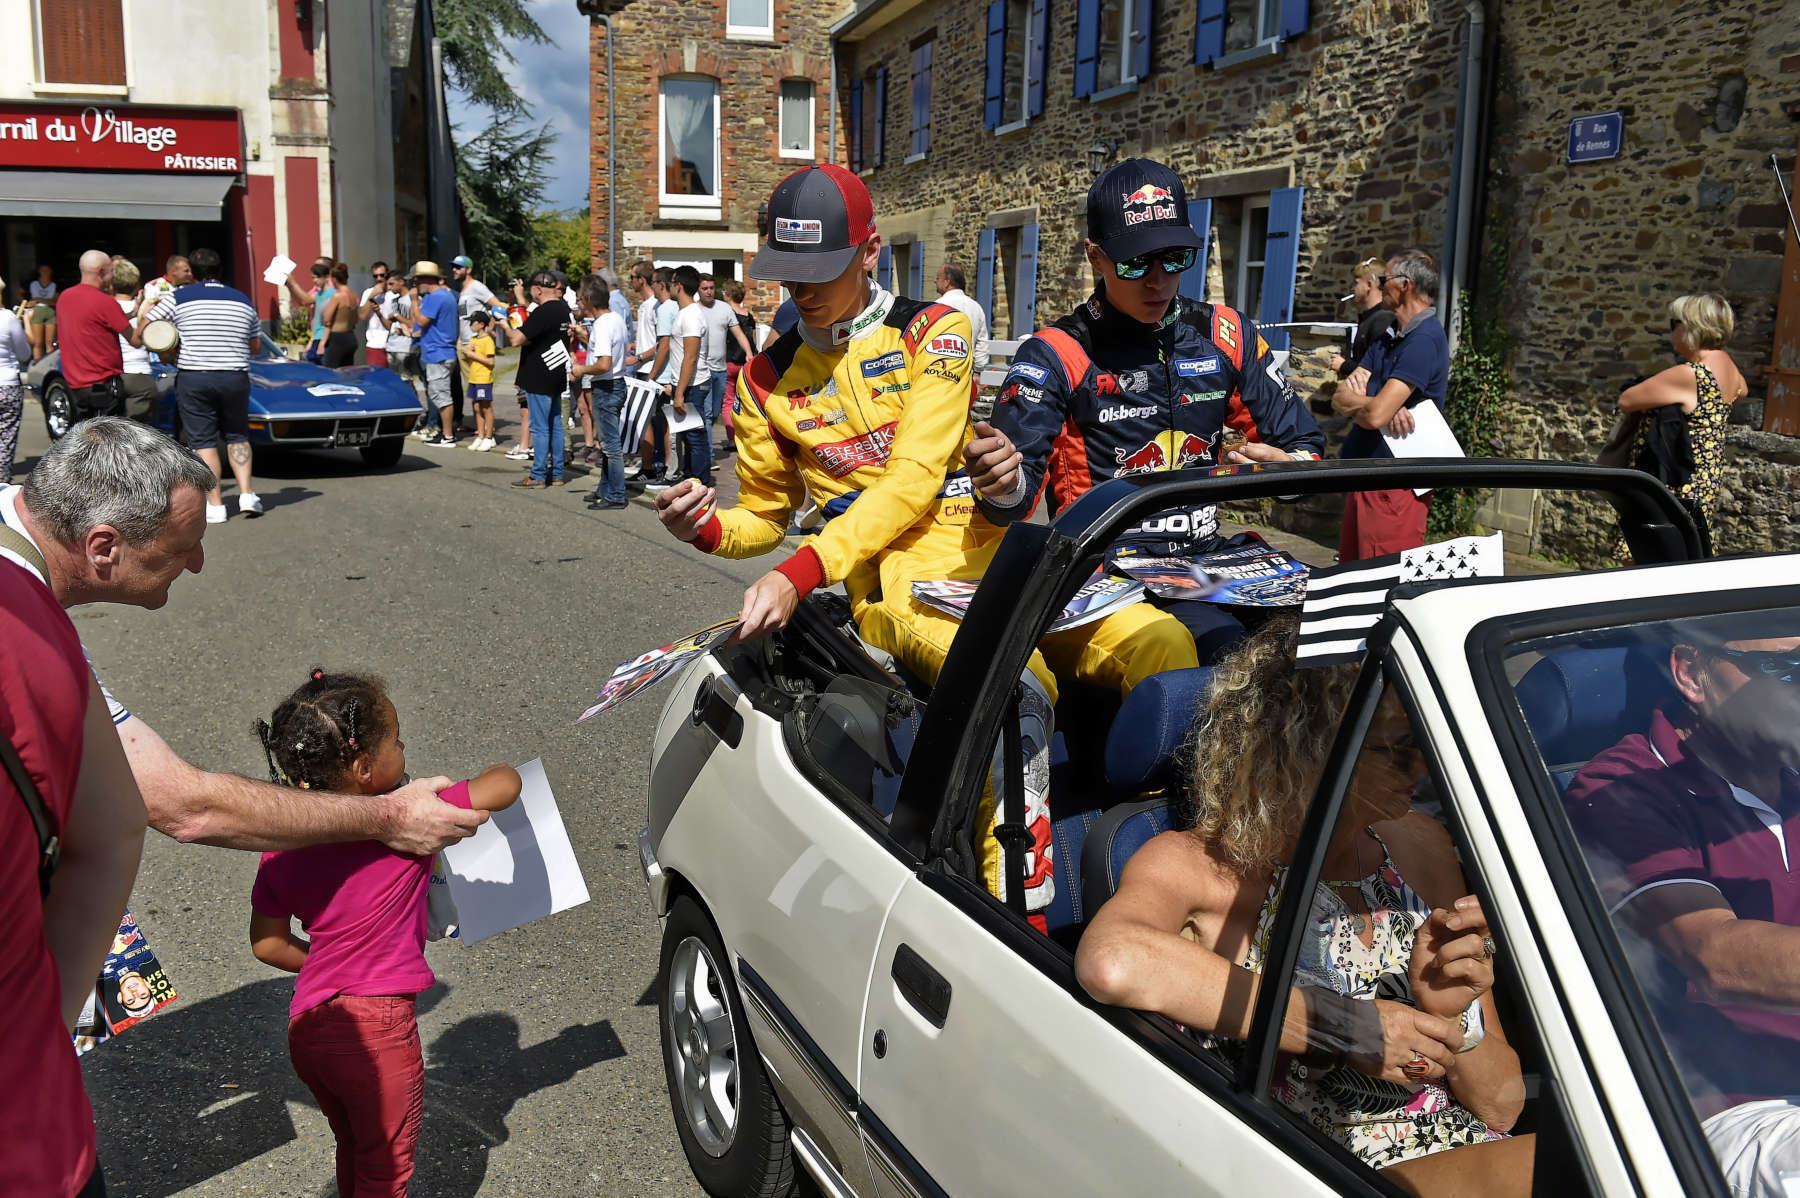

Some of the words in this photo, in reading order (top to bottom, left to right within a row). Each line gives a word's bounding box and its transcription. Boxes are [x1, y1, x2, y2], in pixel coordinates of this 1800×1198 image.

[45, 118, 76, 142] du
[81, 106, 177, 151] Village
[1593, 123, 1608, 134] Rue
[1576, 142, 1585, 152] de
[1586, 140, 1610, 151] Rennes
[164, 153, 237, 170] PÂTISSIER
[1124, 206, 1153, 226] Red
[1154, 203, 1178, 220] Bull
[931, 338, 967, 354] BELL
[1098, 404, 1158, 423] Olsbergs
